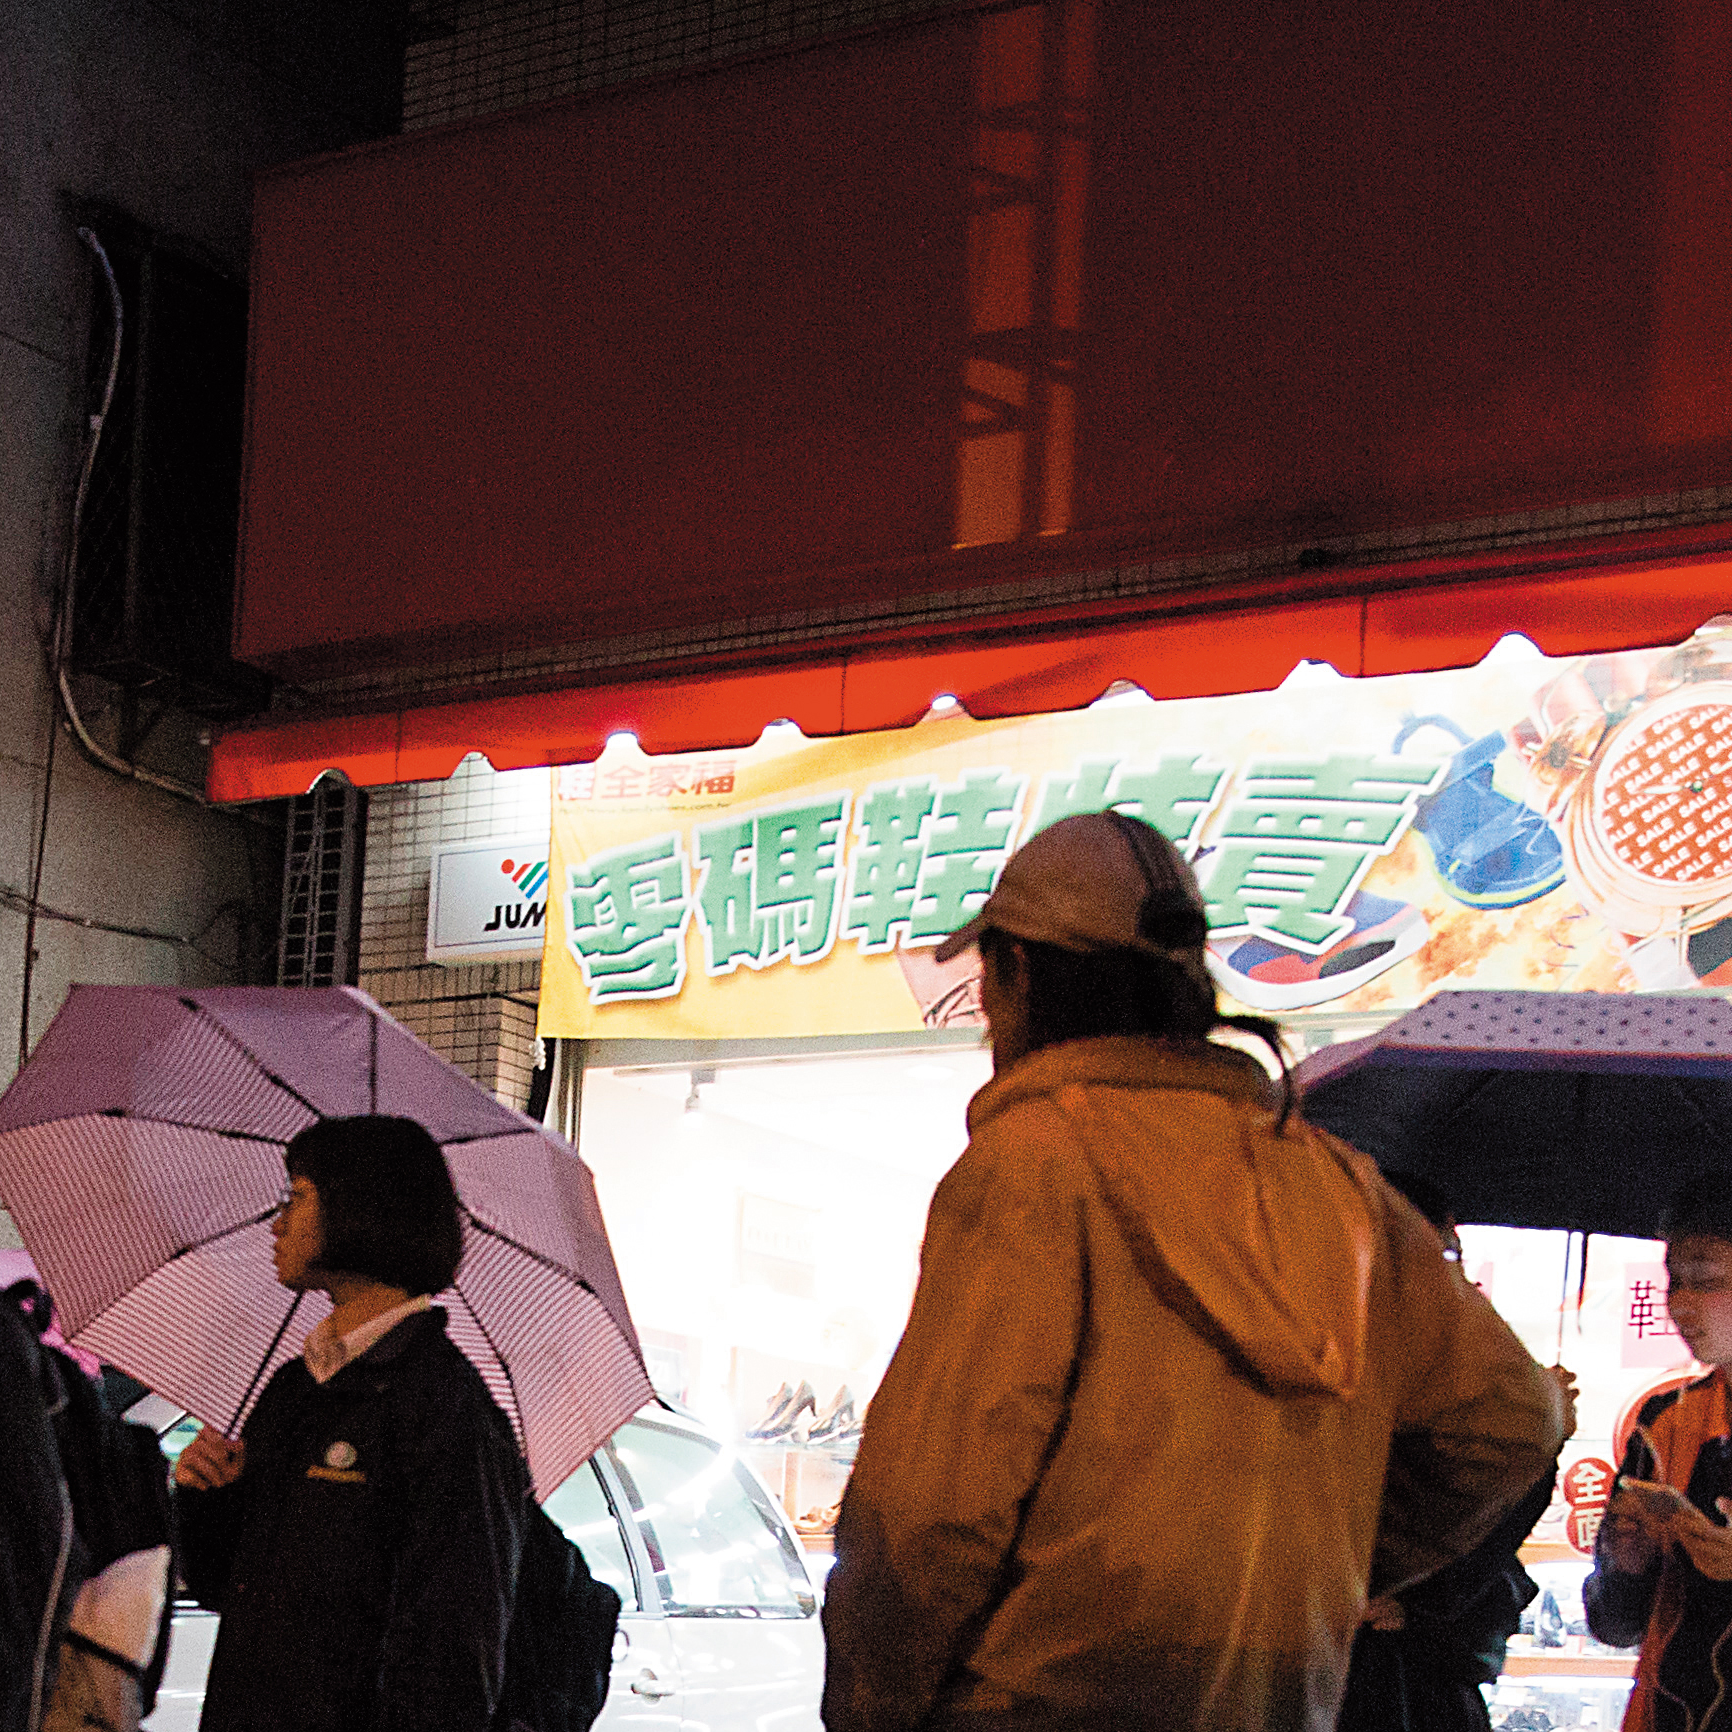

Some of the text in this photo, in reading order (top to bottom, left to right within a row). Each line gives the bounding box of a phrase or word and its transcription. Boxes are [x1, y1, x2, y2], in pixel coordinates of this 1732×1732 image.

[1646, 729, 1684, 758] SALE
[1669, 734, 1707, 763] SALE
[1625, 763, 1663, 792] SALE
[1662, 758, 1700, 785] SALE
[1642, 795, 1680, 823] SALE
[1679, 788, 1717, 818] SALE
[1637, 818, 1675, 847] SALE
[1659, 823, 1697, 852] SALE
[1653, 847, 1691, 876] SALE
[1676, 853, 1713, 881] SALE
